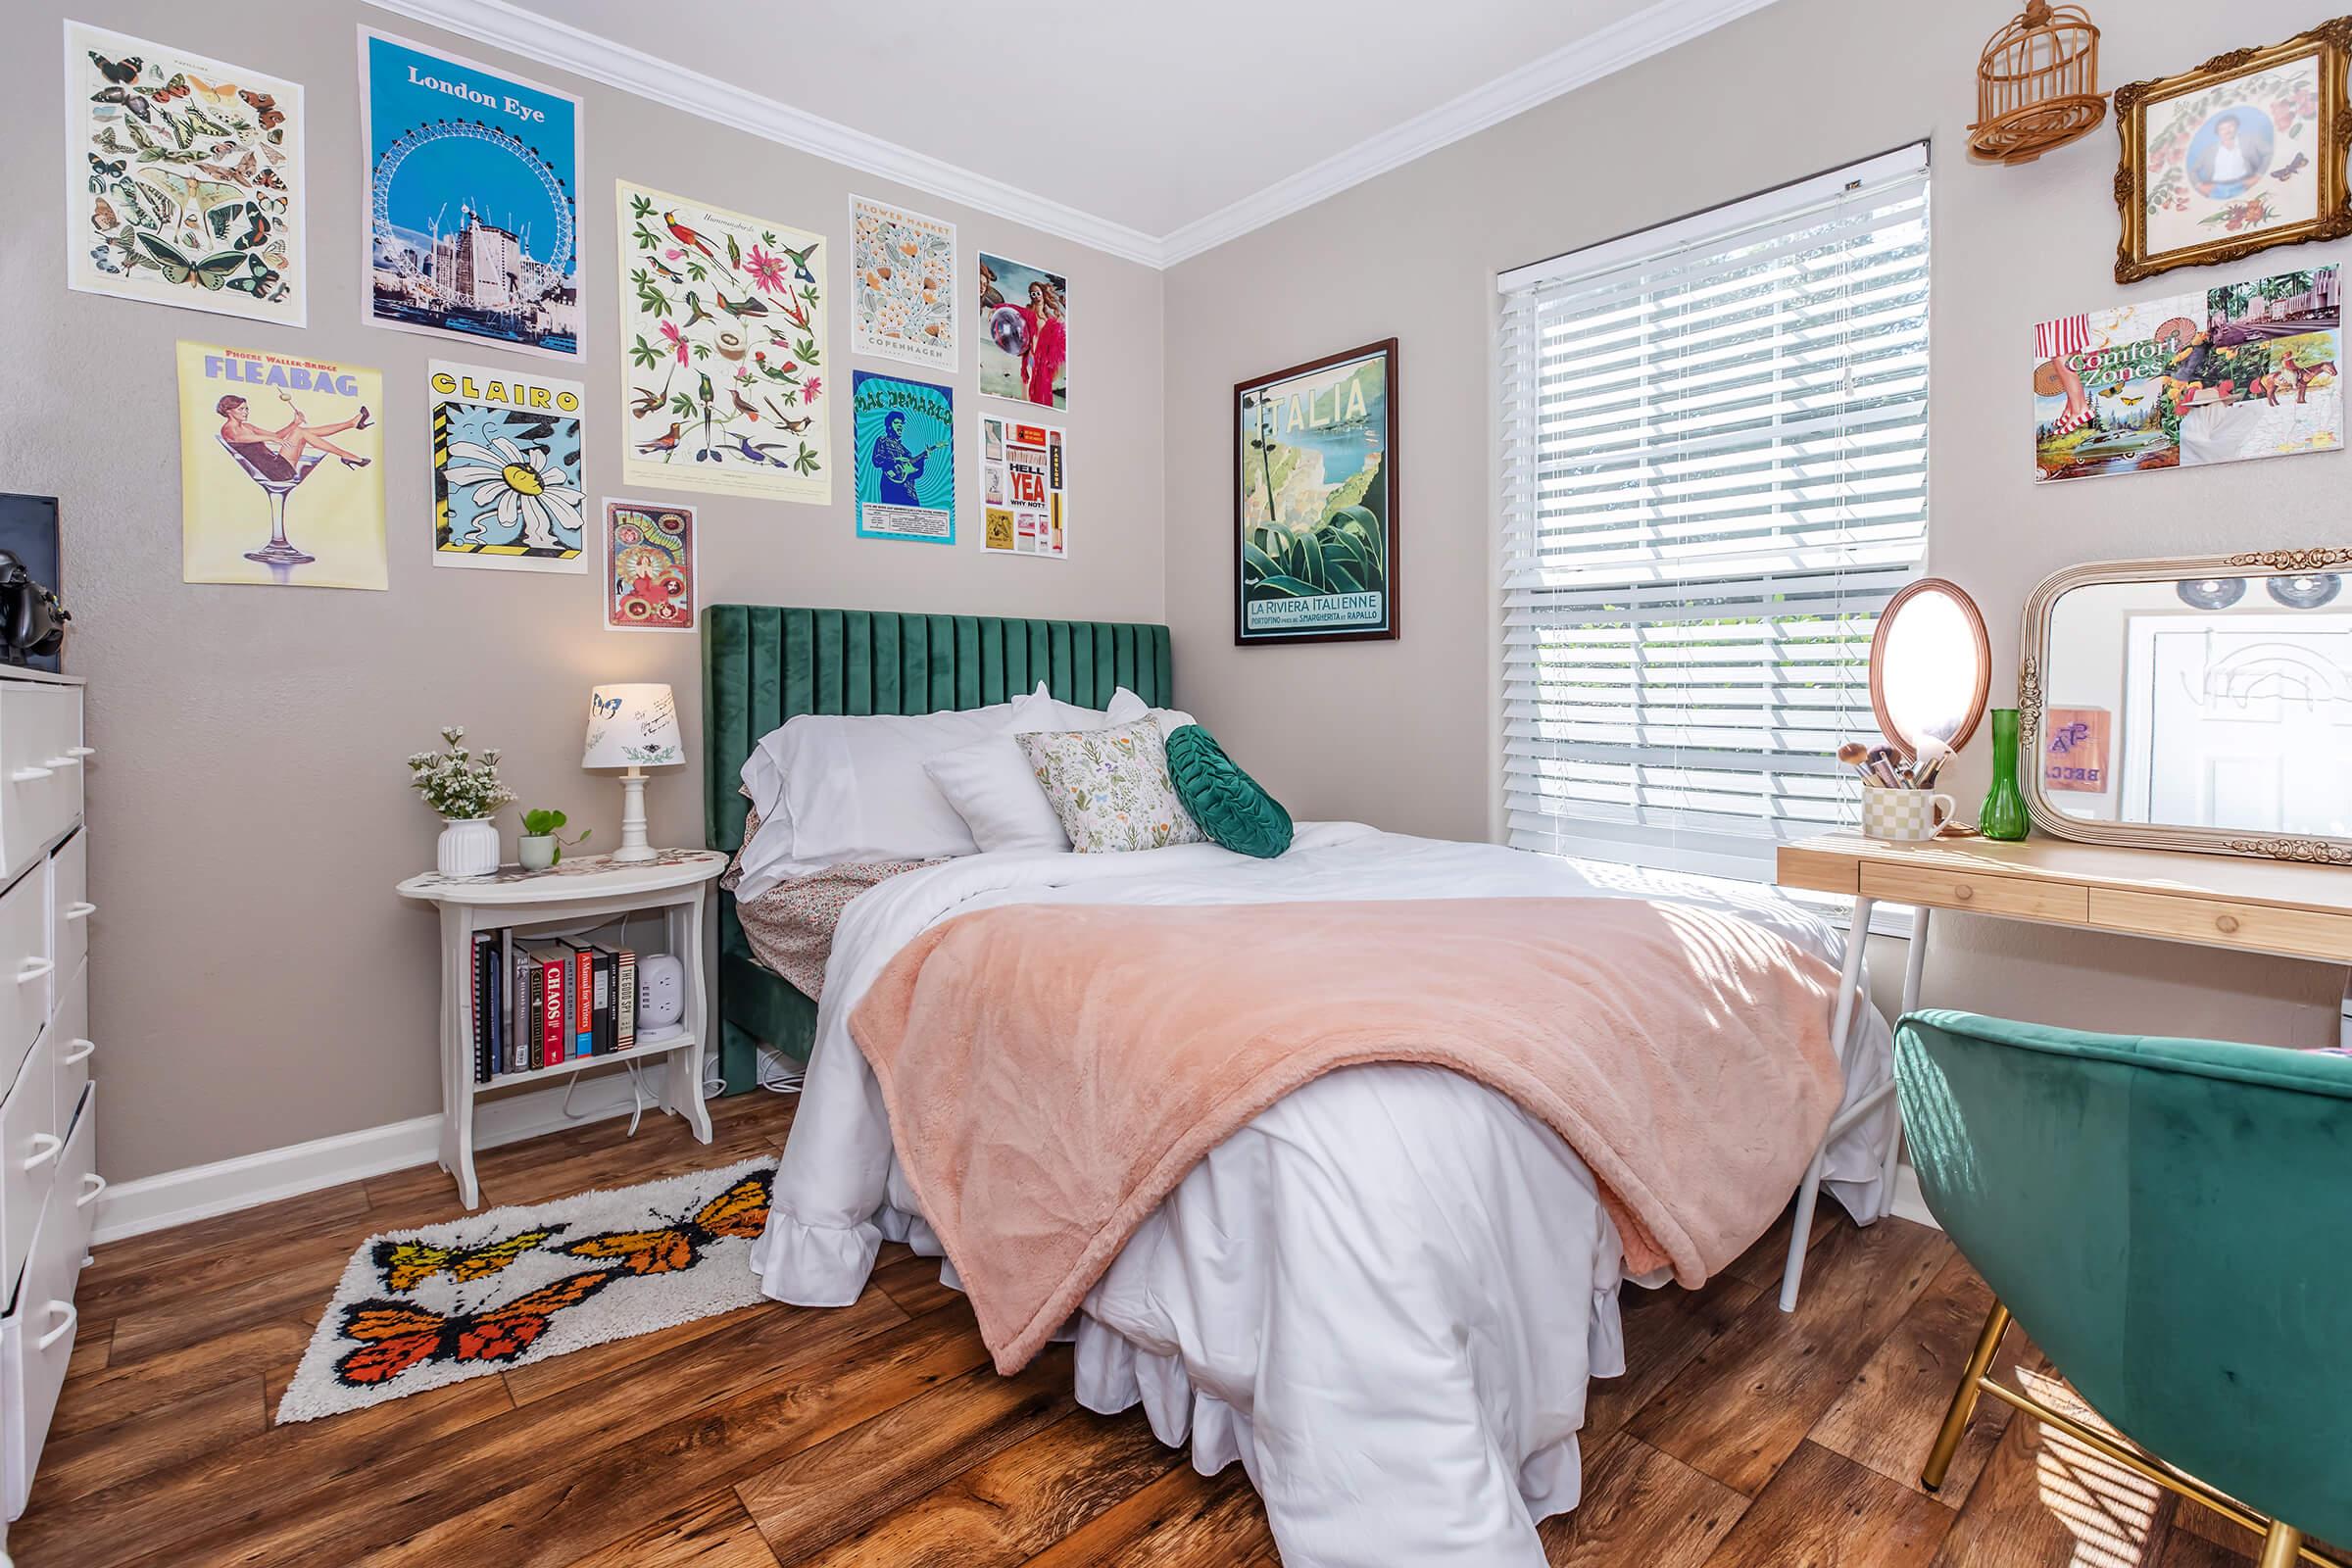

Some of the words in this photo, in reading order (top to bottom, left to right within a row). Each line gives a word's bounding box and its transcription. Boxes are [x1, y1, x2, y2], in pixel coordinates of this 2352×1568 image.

[408, 66, 497, 109] London
[503, 96, 545, 122] Eye
[856, 203, 903, 220] FLOWER
[906, 217, 949, 235] MARKET
[868, 337, 943, 358] COPENHAGEN
[2068, 337, 2179, 371] Comfort
[225, 350, 262, 362] PHOEBE
[266, 356, 337, 372] WALLER-BRIDGE
[205, 355, 358, 397] FLEABAG
[2085, 362, 2162, 387] Zones
[431, 372, 579, 412] CLAIRO
[854, 391, 885, 413] MAC
[1257, 378, 1367, 440] ITALIA
[1009, 463, 1045, 475] HELL
[1010, 471, 1045, 502] YEA
[1251, 604, 1264, 614] LA
[1266, 600, 1309, 614] RIVIERA
[1313, 595, 1377, 611] ITALIENNE
[1251, 616, 1281, 625] PORTOFINO
[1348, 611, 1377, 620] RAPALLO
[582, 962, 591, 989] Manual
[621, 969, 632, 981] THE
[547, 967, 561, 1020] CHAOS
[582, 990, 591, 1001] for
[621, 982, 632, 1000] GOOD
[621, 1001, 632, 1013] SPY
